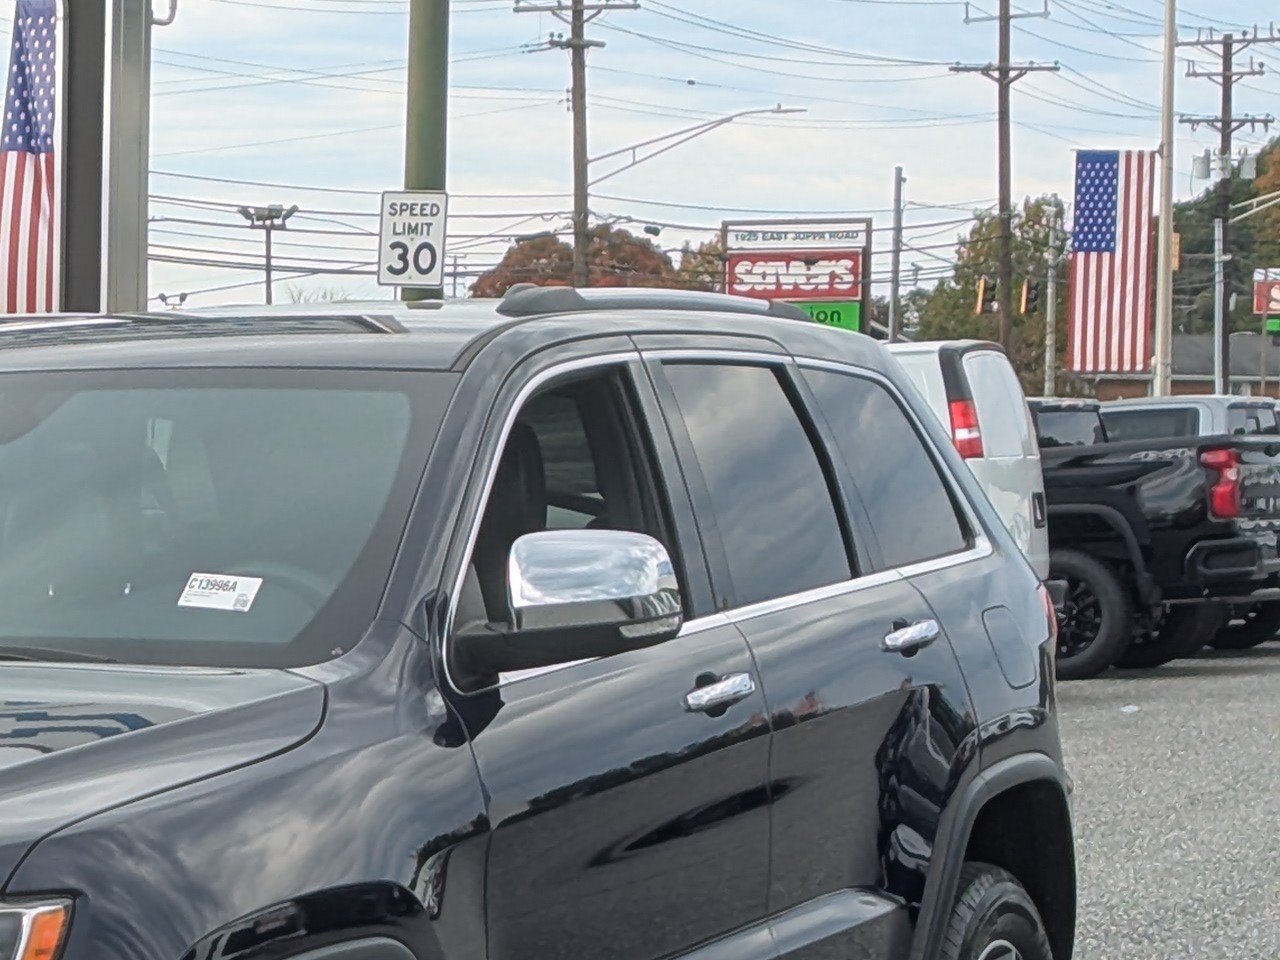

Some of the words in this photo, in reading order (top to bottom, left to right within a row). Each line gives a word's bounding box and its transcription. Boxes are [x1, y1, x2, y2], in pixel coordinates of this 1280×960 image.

[388, 202, 440, 217] SPEED
[392, 222, 433, 236] LIMIT
[762, 231, 788, 241] EAST
[792, 231, 827, 241] JOPPA
[829, 230, 859, 240] ROAD
[386, 241, 437, 275] 30
[188, 577, 238, 592] C13996A
